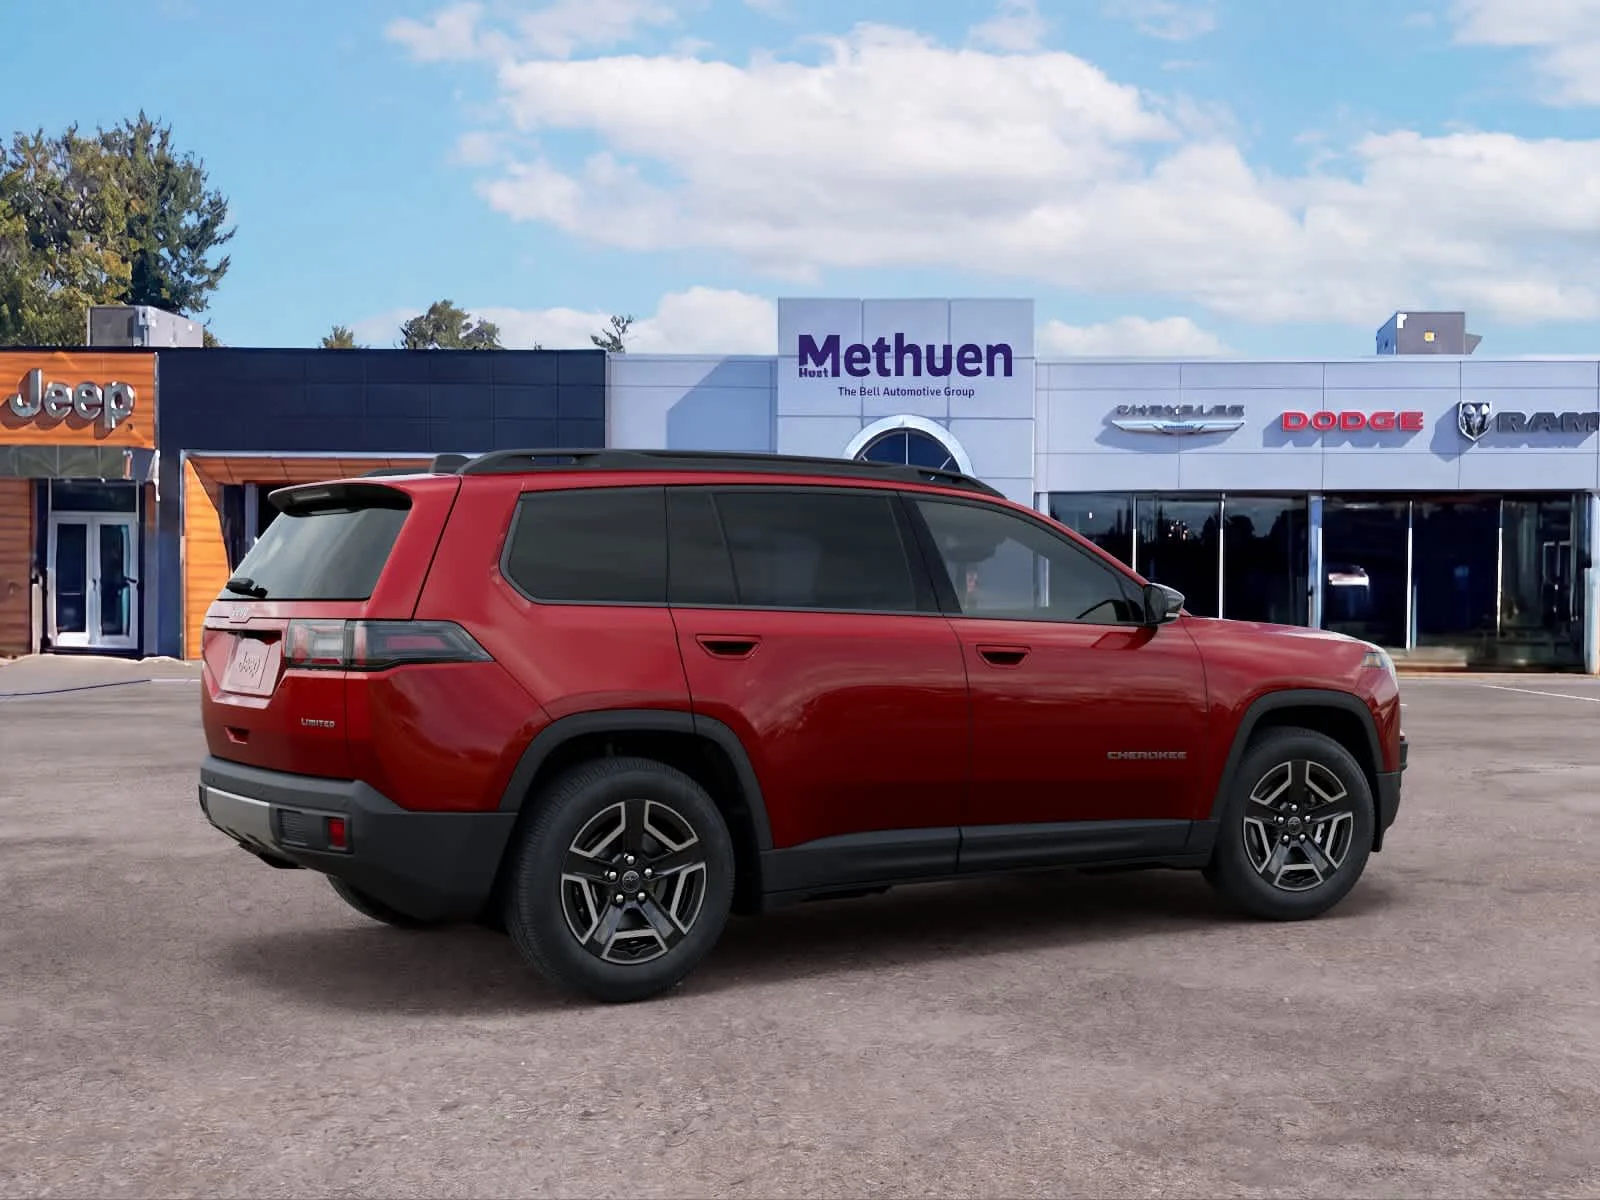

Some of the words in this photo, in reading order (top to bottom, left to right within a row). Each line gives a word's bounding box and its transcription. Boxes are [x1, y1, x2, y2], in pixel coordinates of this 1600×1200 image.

[799, 333, 1013, 378] Methuen
[9, 368, 136, 430] Jeep
[838, 386, 857, 397] The
[859, 386, 881, 397] Bell
[883, 386, 942, 397] Automotive
[944, 386, 976, 399] Group
[1282, 411, 1424, 432] DODGE
[1497, 411, 1600, 433] RAM
[300, 717, 336, 728] LIMITED
[1106, 751, 1188, 760] CHEROKEE
